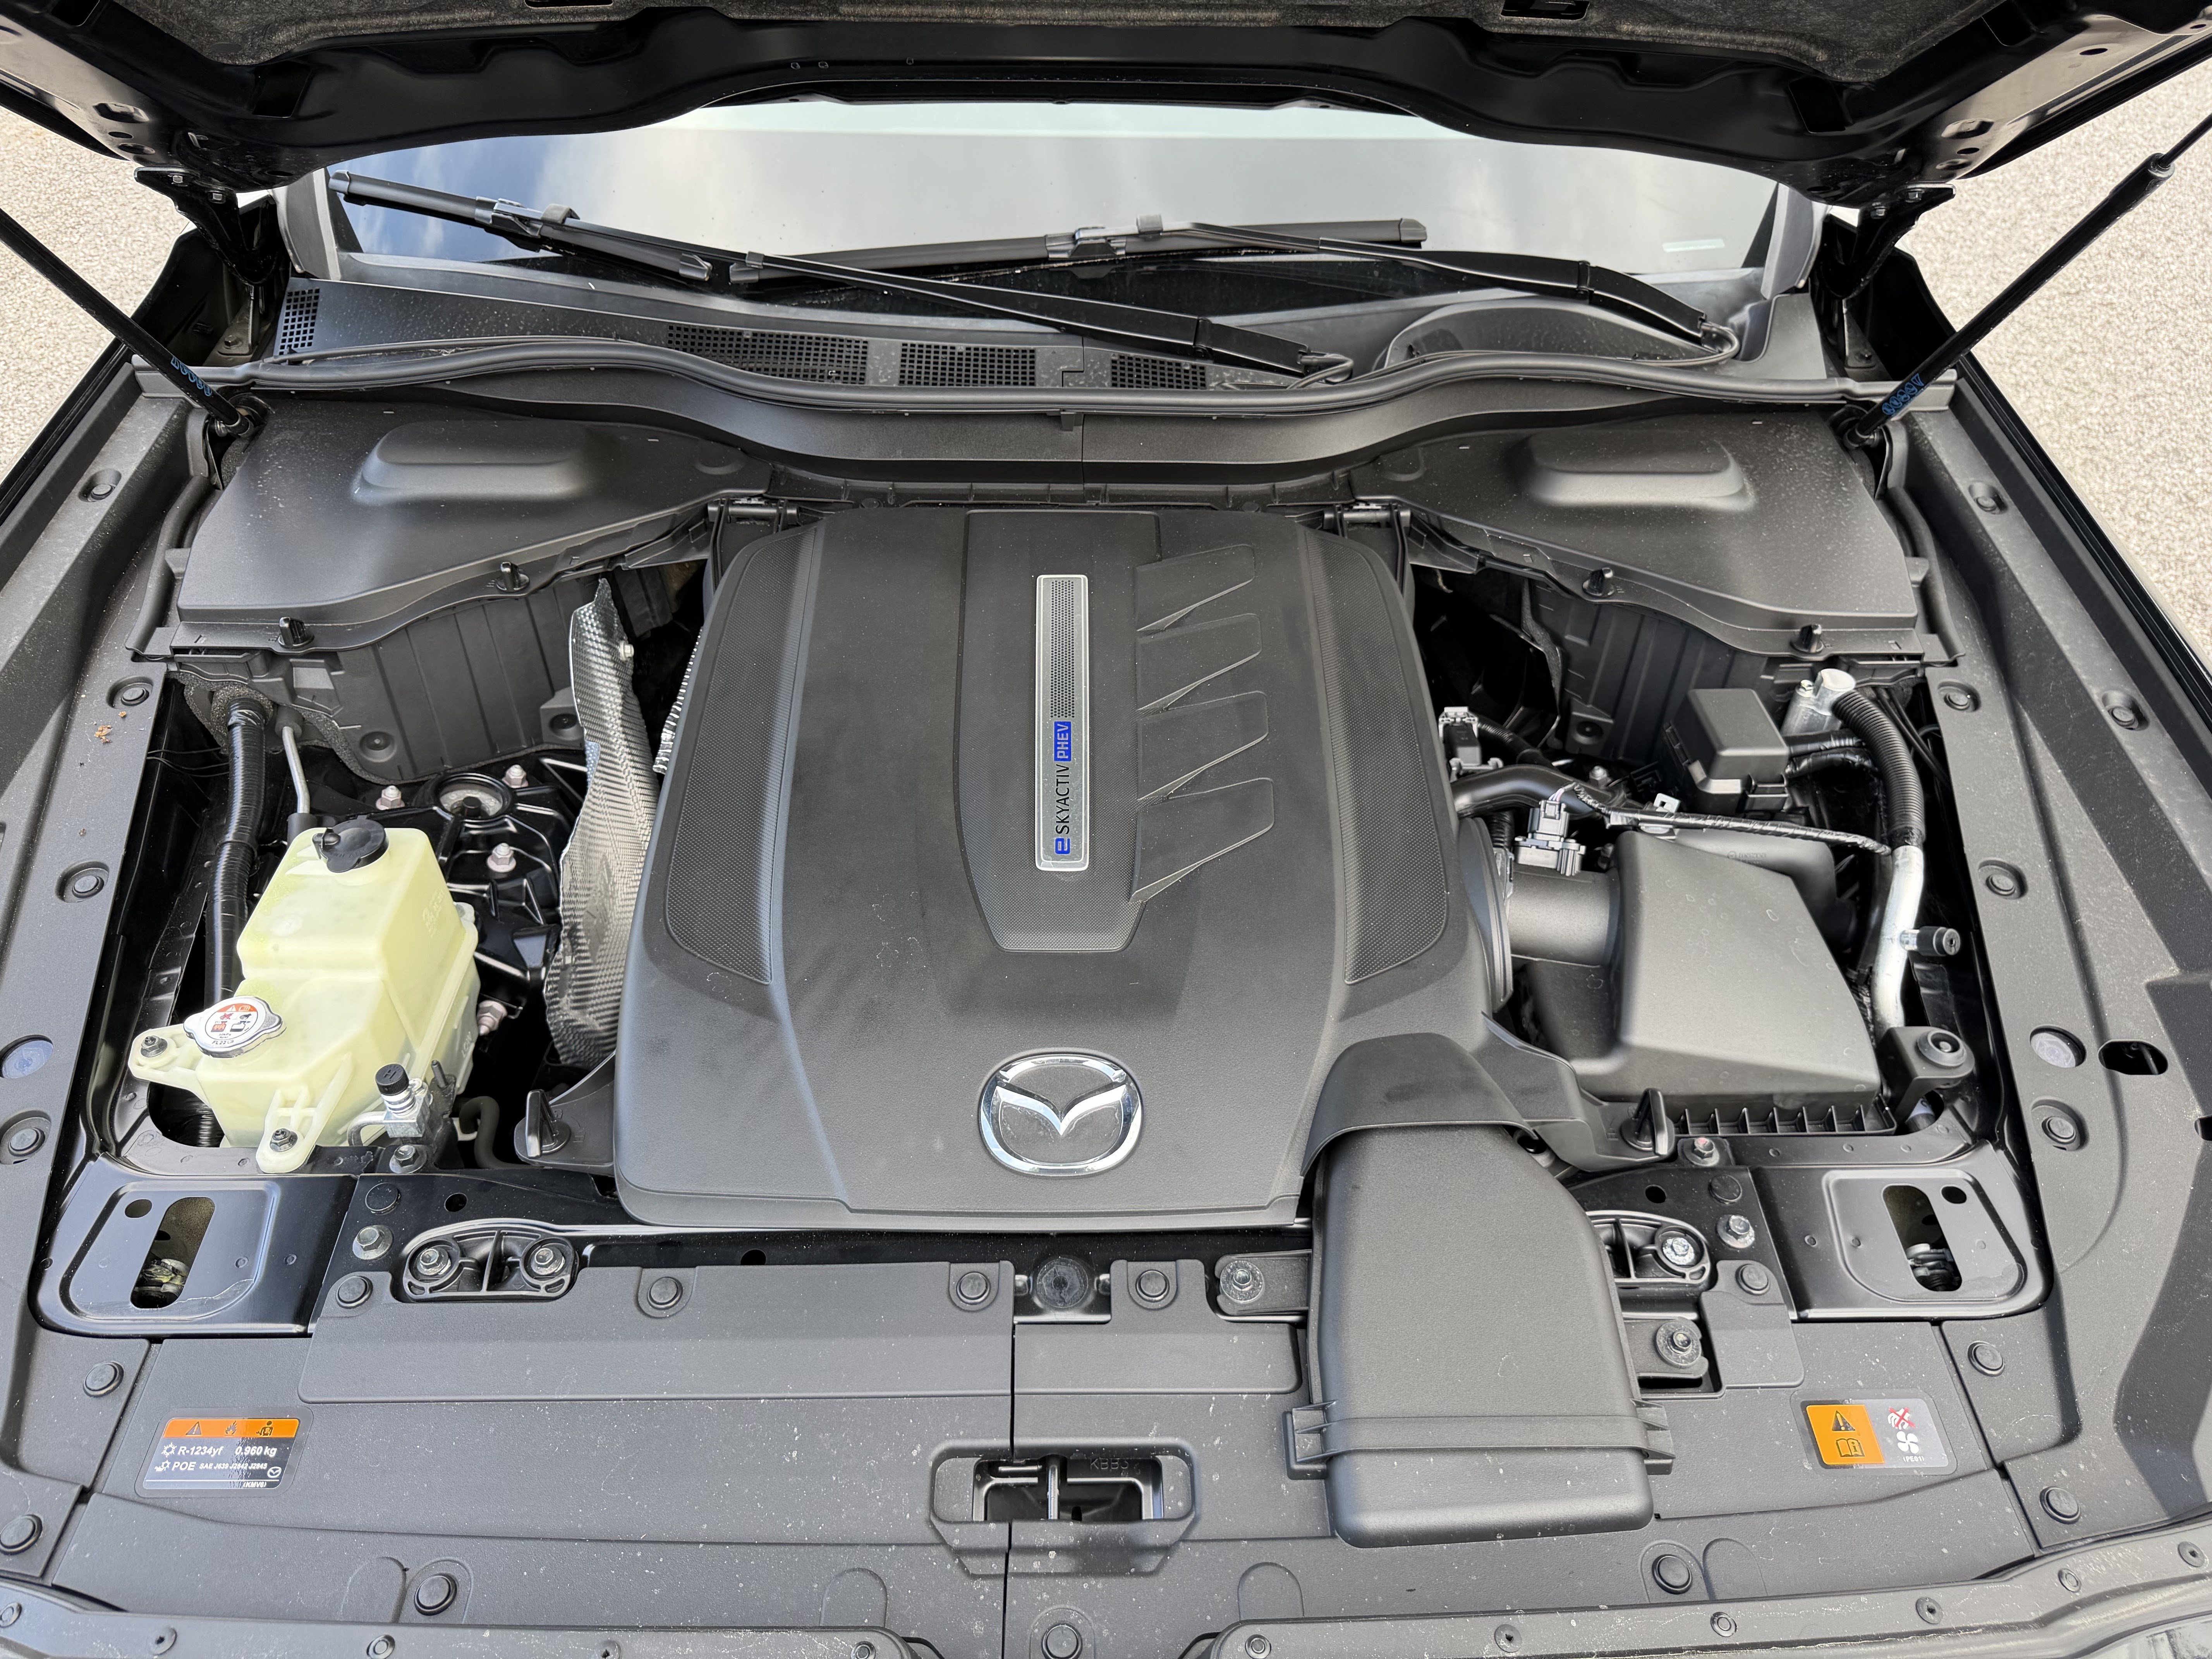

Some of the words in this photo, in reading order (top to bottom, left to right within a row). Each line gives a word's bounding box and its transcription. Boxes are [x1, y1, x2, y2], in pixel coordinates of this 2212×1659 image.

[1057, 723, 1069, 759] PHEV
[1055, 764, 1070, 835] SKYACTIV
[178, 1446, 224, 1457] R-1234yf
[235, 1446, 263, 1455] 0.960
[263, 1446, 277, 1457] kg
[172, 1462, 196, 1470] POE
